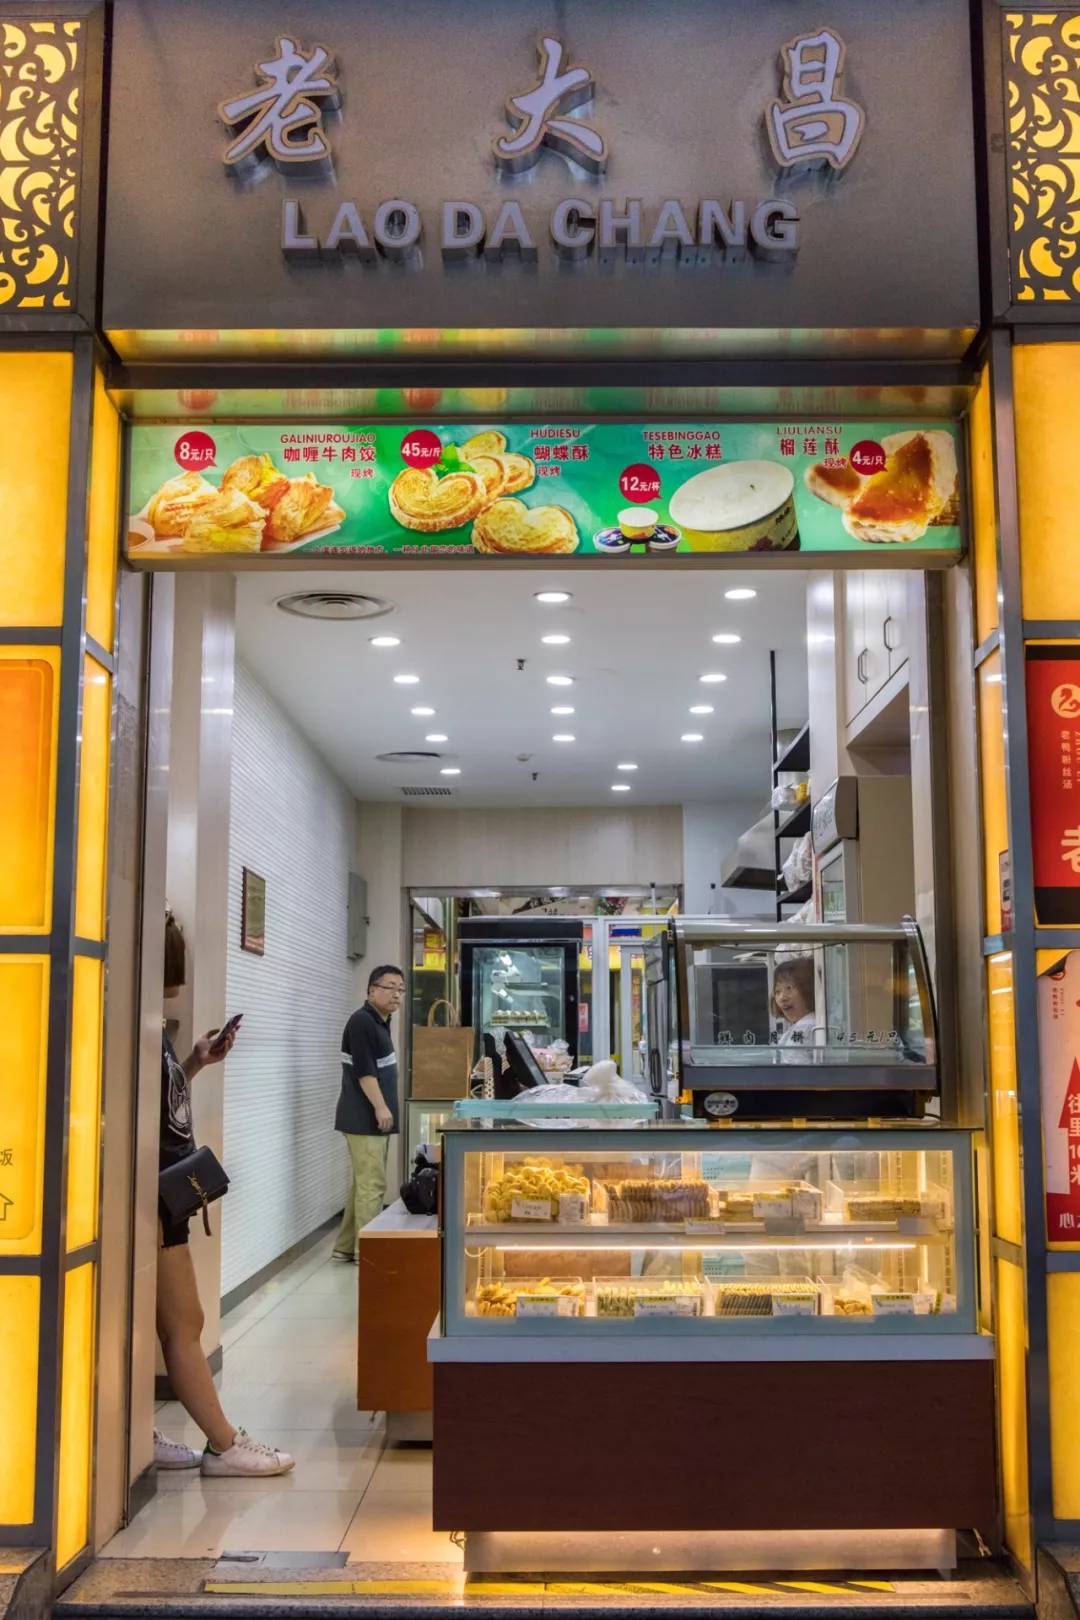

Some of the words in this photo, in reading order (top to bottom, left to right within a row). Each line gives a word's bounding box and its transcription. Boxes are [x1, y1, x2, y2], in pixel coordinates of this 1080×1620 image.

[217, 30, 865, 168] 老大昌
[281, 198, 422, 249] LAO
[441, 199, 536, 249] DA
[550, 198, 799, 250] CHANG
[530, 428, 580, 438] HUDIESU
[643, 431, 720, 440] TESEBINGGAO
[776, 424, 843, 435] LIULIANSU
[280, 433, 376, 444] GALINIUROUJIAO
[780, 437, 841, 456] 榴莲酥
[179, 441, 214, 461] 8元/只
[283, 446, 376, 462] 咖喱牛肉饺
[401, 442, 441, 458] 45元/斤
[534, 445, 589, 461] 蝴蝶酥
[648, 443, 723, 460] 特色冰糕
[852, 450, 884, 466] 4元/只
[621, 476, 661, 492] 12元/杯
